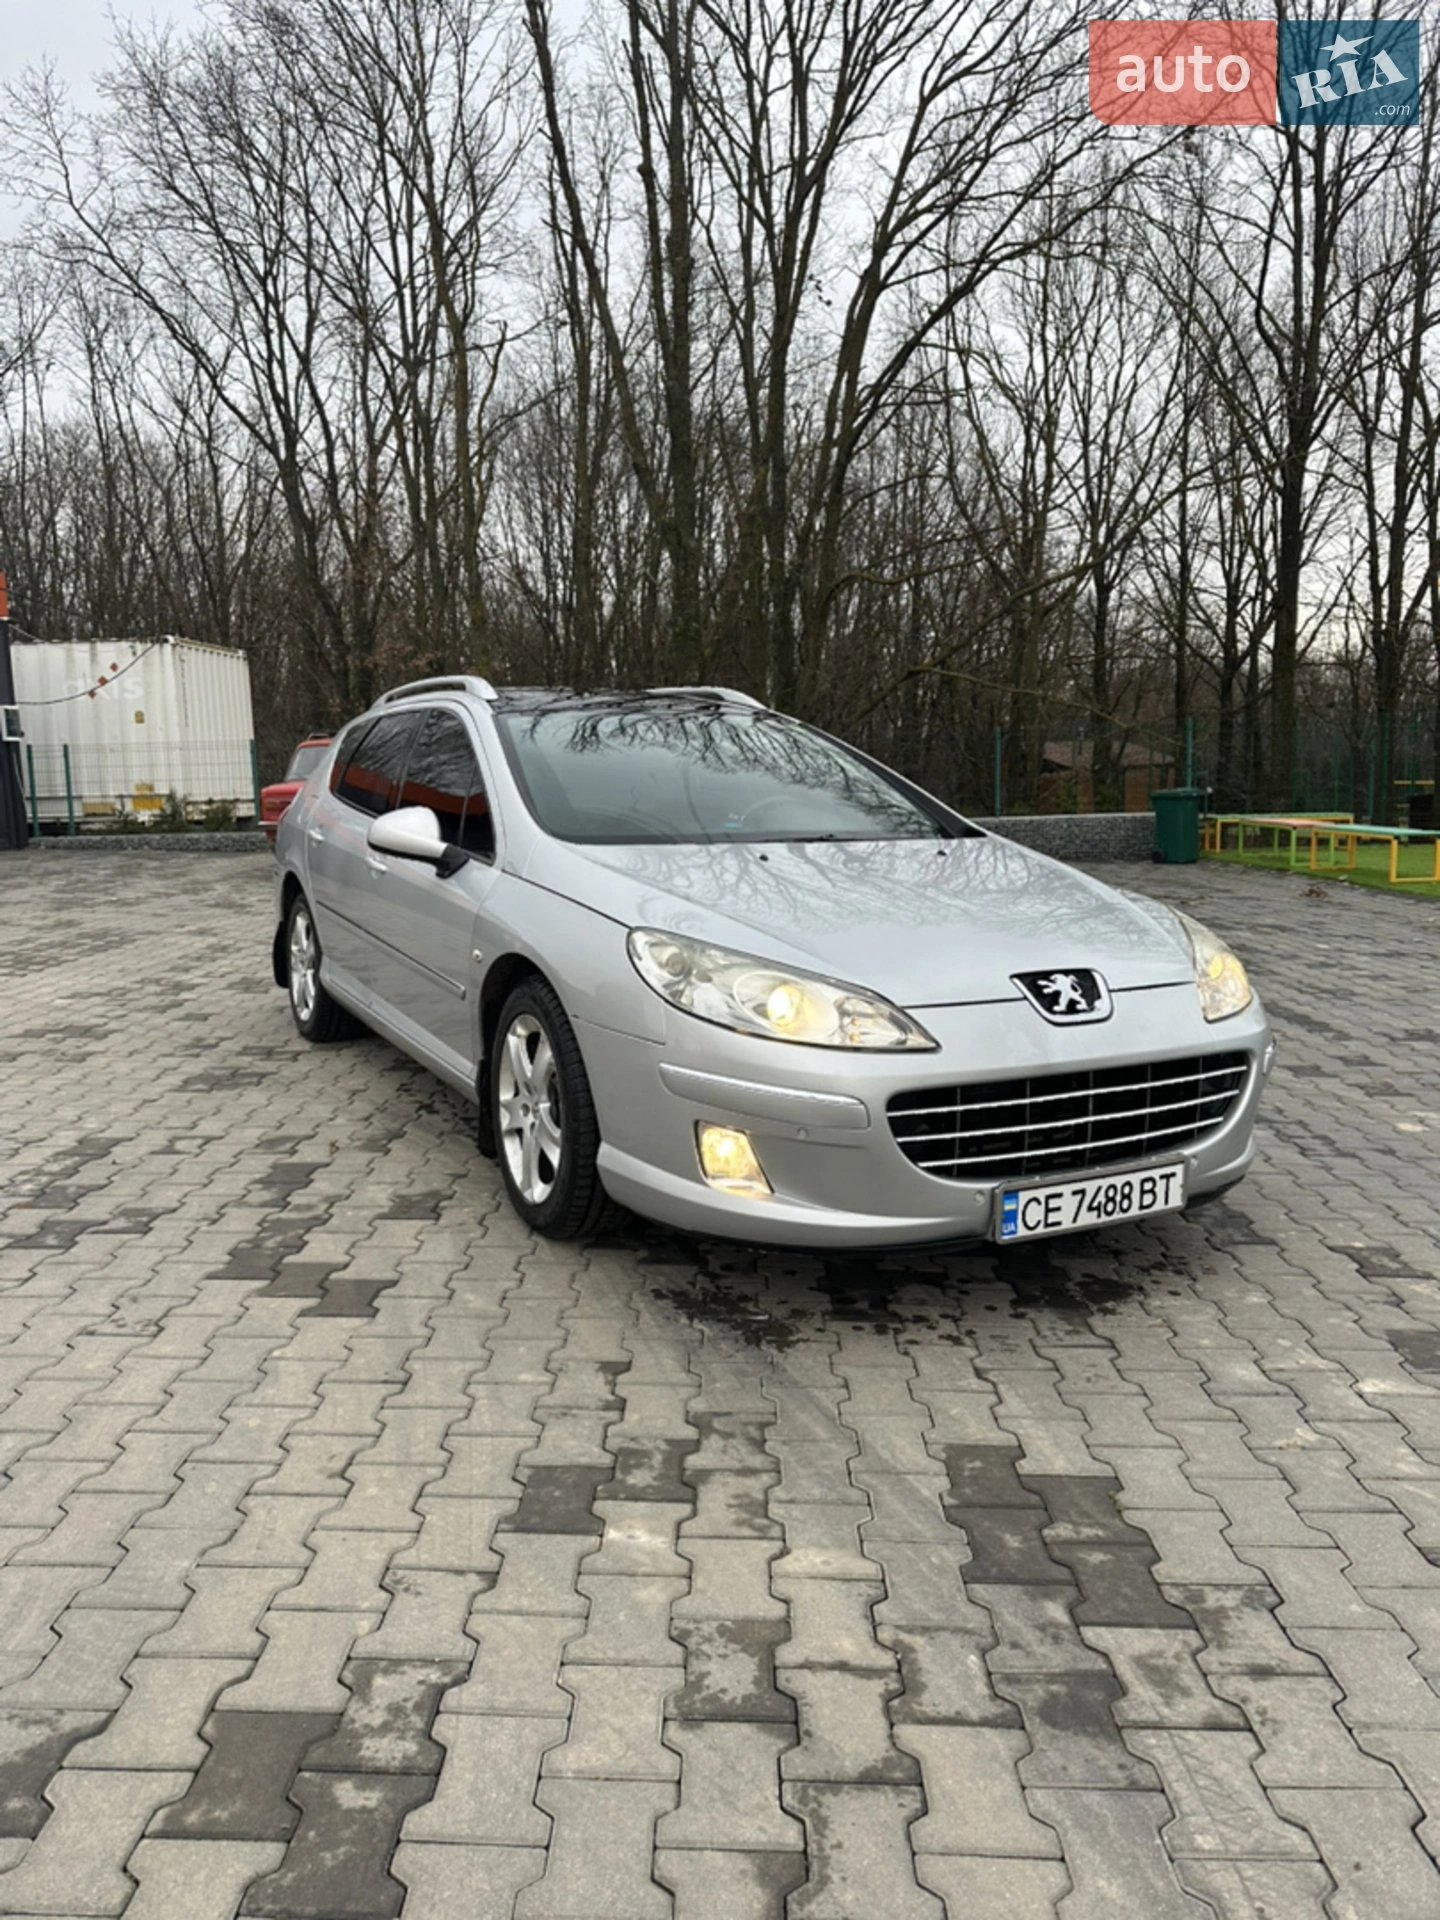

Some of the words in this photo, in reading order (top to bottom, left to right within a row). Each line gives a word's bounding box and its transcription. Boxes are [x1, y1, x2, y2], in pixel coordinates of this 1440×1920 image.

[1021, 1192, 1064, 1231] CE
[1071, 1180, 1134, 1224] 7488
[1138, 1171, 1177, 1211] BT
[1002, 1221, 1016, 1234] UA
